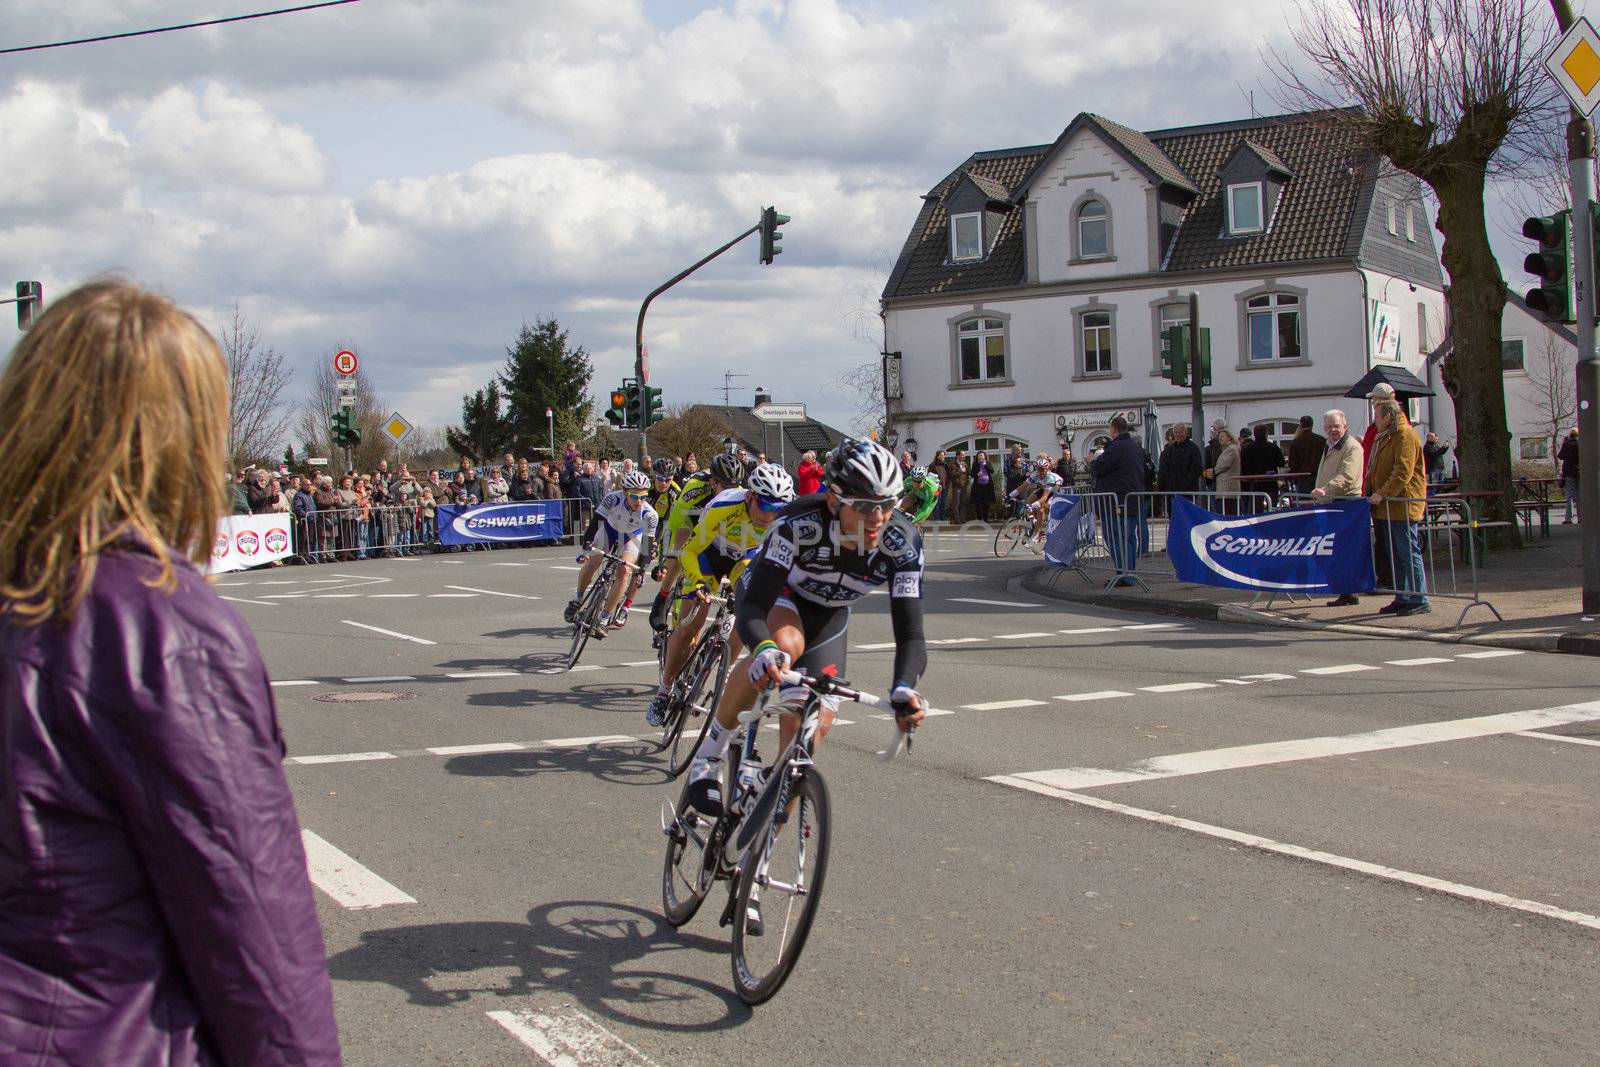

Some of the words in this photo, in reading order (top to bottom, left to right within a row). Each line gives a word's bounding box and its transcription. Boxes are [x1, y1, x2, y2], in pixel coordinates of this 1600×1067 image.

[467, 514, 546, 528] SCHWALBE
[1210, 533, 1336, 556] SCHWALBE
[895, 575, 917, 587] play
[897, 585, 917, 594] itas
